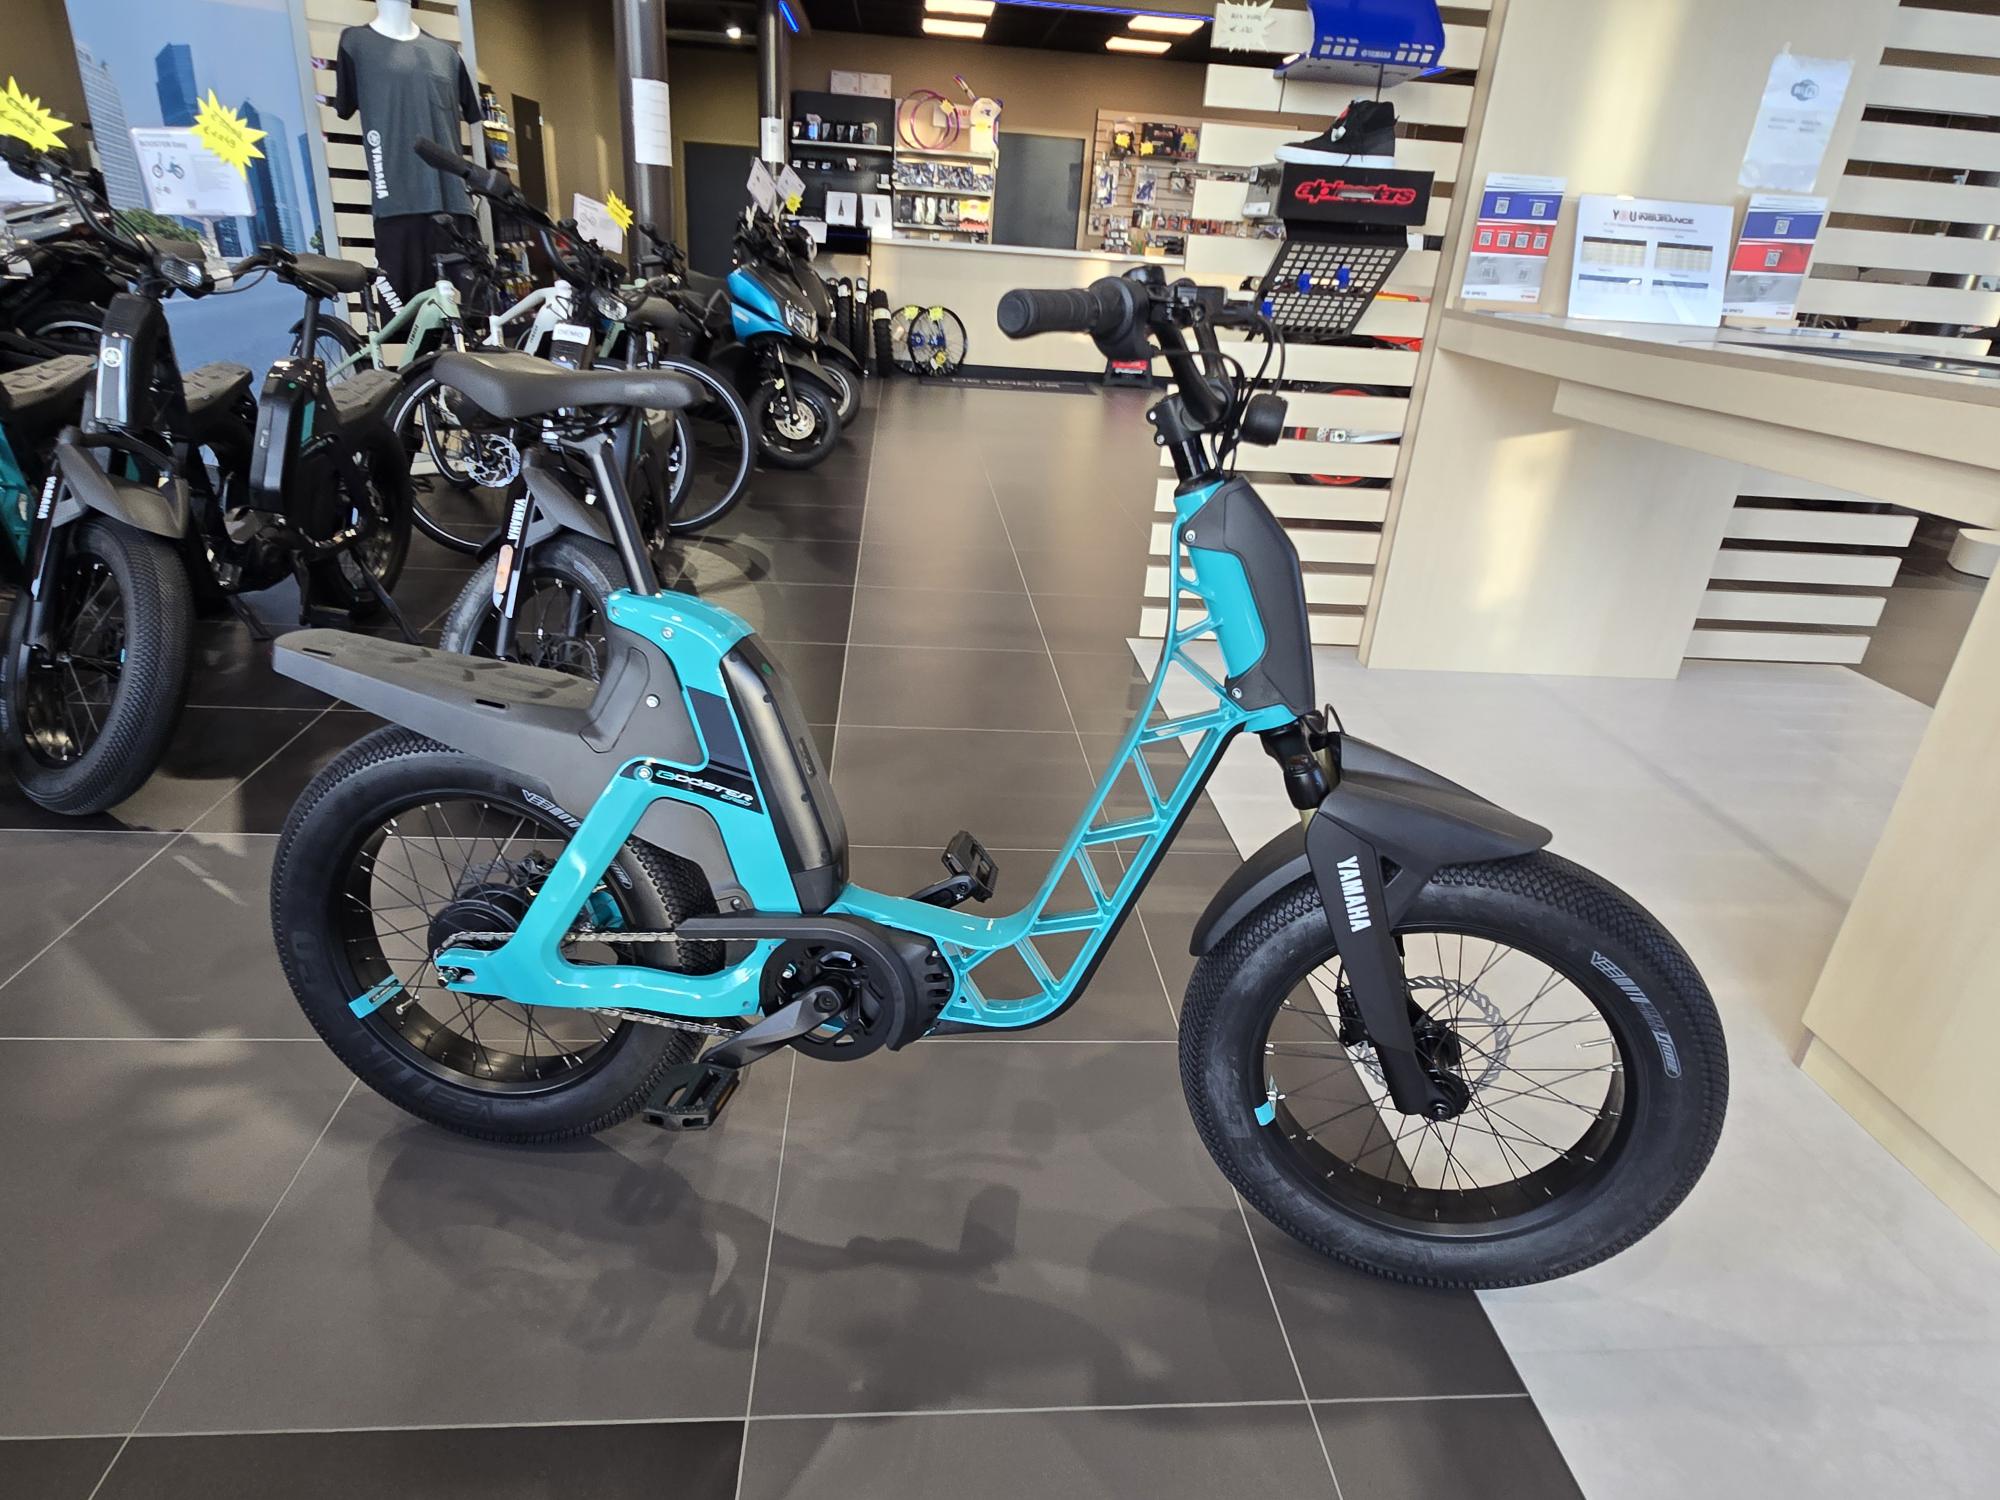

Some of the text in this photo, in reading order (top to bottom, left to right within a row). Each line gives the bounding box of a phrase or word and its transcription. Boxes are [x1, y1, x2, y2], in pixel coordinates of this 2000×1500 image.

[371, 146, 389, 199] YAMAHA
[37, 476, 57, 519] YAMAHA
[507, 499, 526, 540] YAMAHA
[656, 770, 754, 801] BOOSTER
[1337, 855, 1371, 933] YAMAHA
